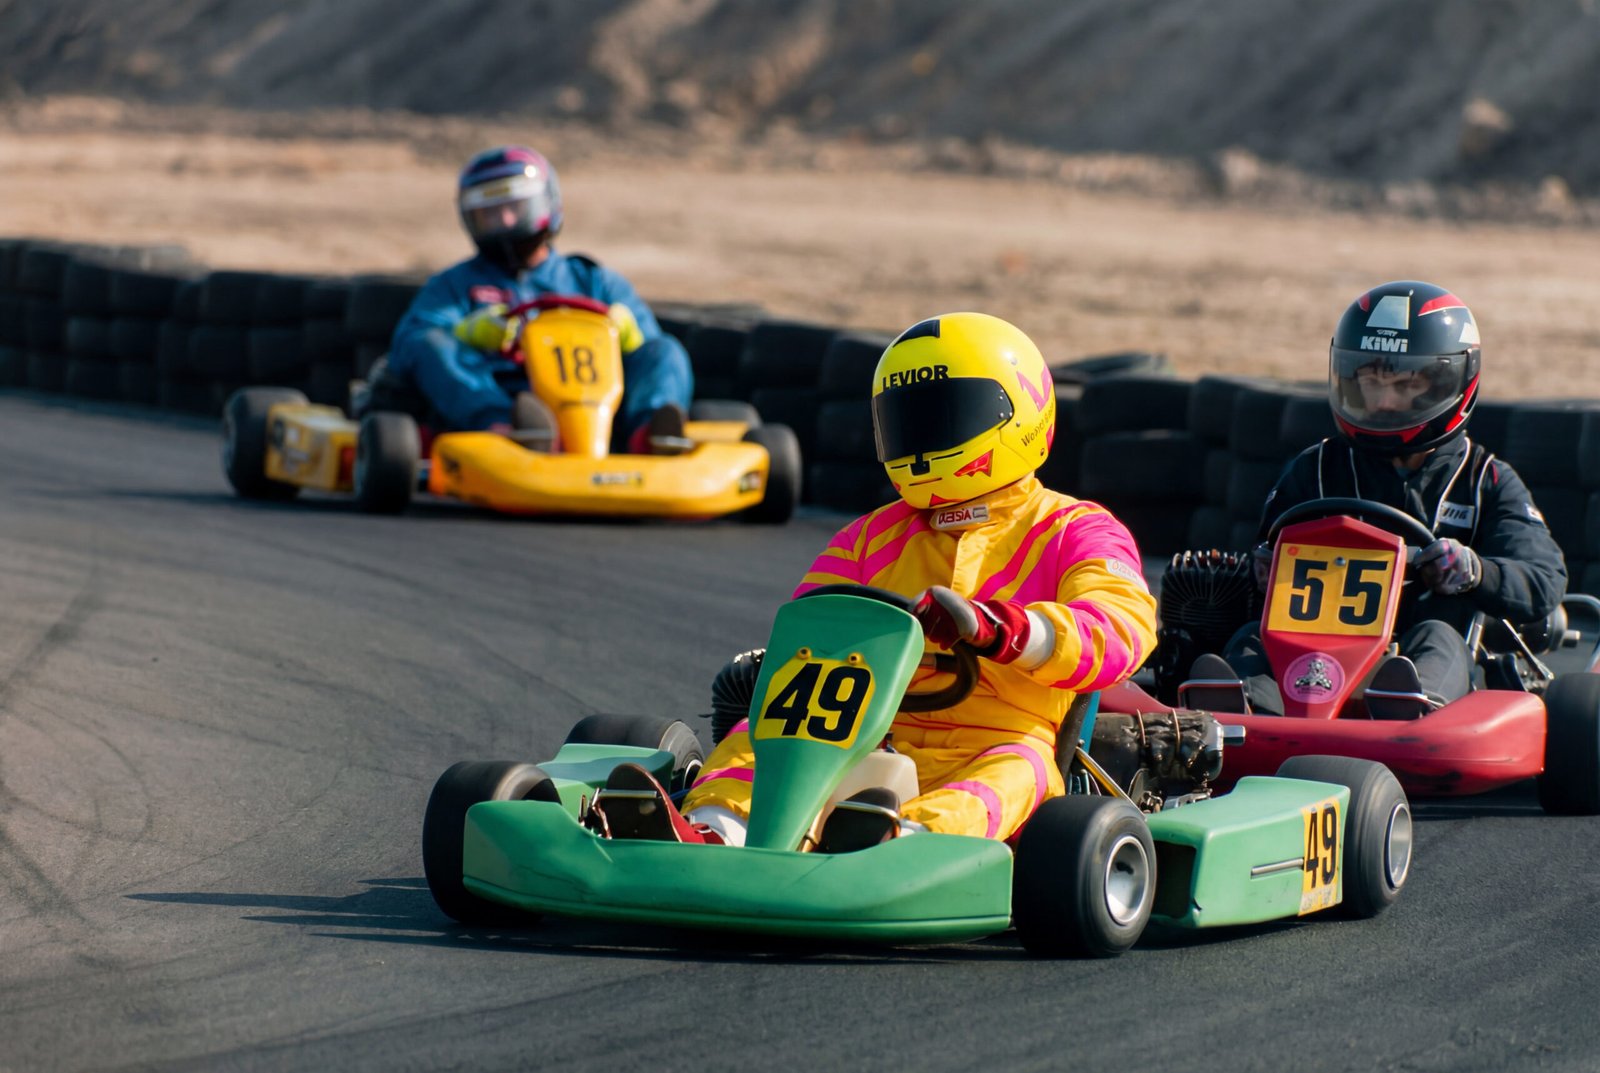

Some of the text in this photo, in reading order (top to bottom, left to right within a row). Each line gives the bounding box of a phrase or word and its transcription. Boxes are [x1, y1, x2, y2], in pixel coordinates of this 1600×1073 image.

[553, 346, 597, 383] 18
[882, 365, 950, 392] LEVIOR
[1289, 559, 1388, 626] 55
[764, 663, 871, 742] 49
[1306, 804, 1337, 888] 49
